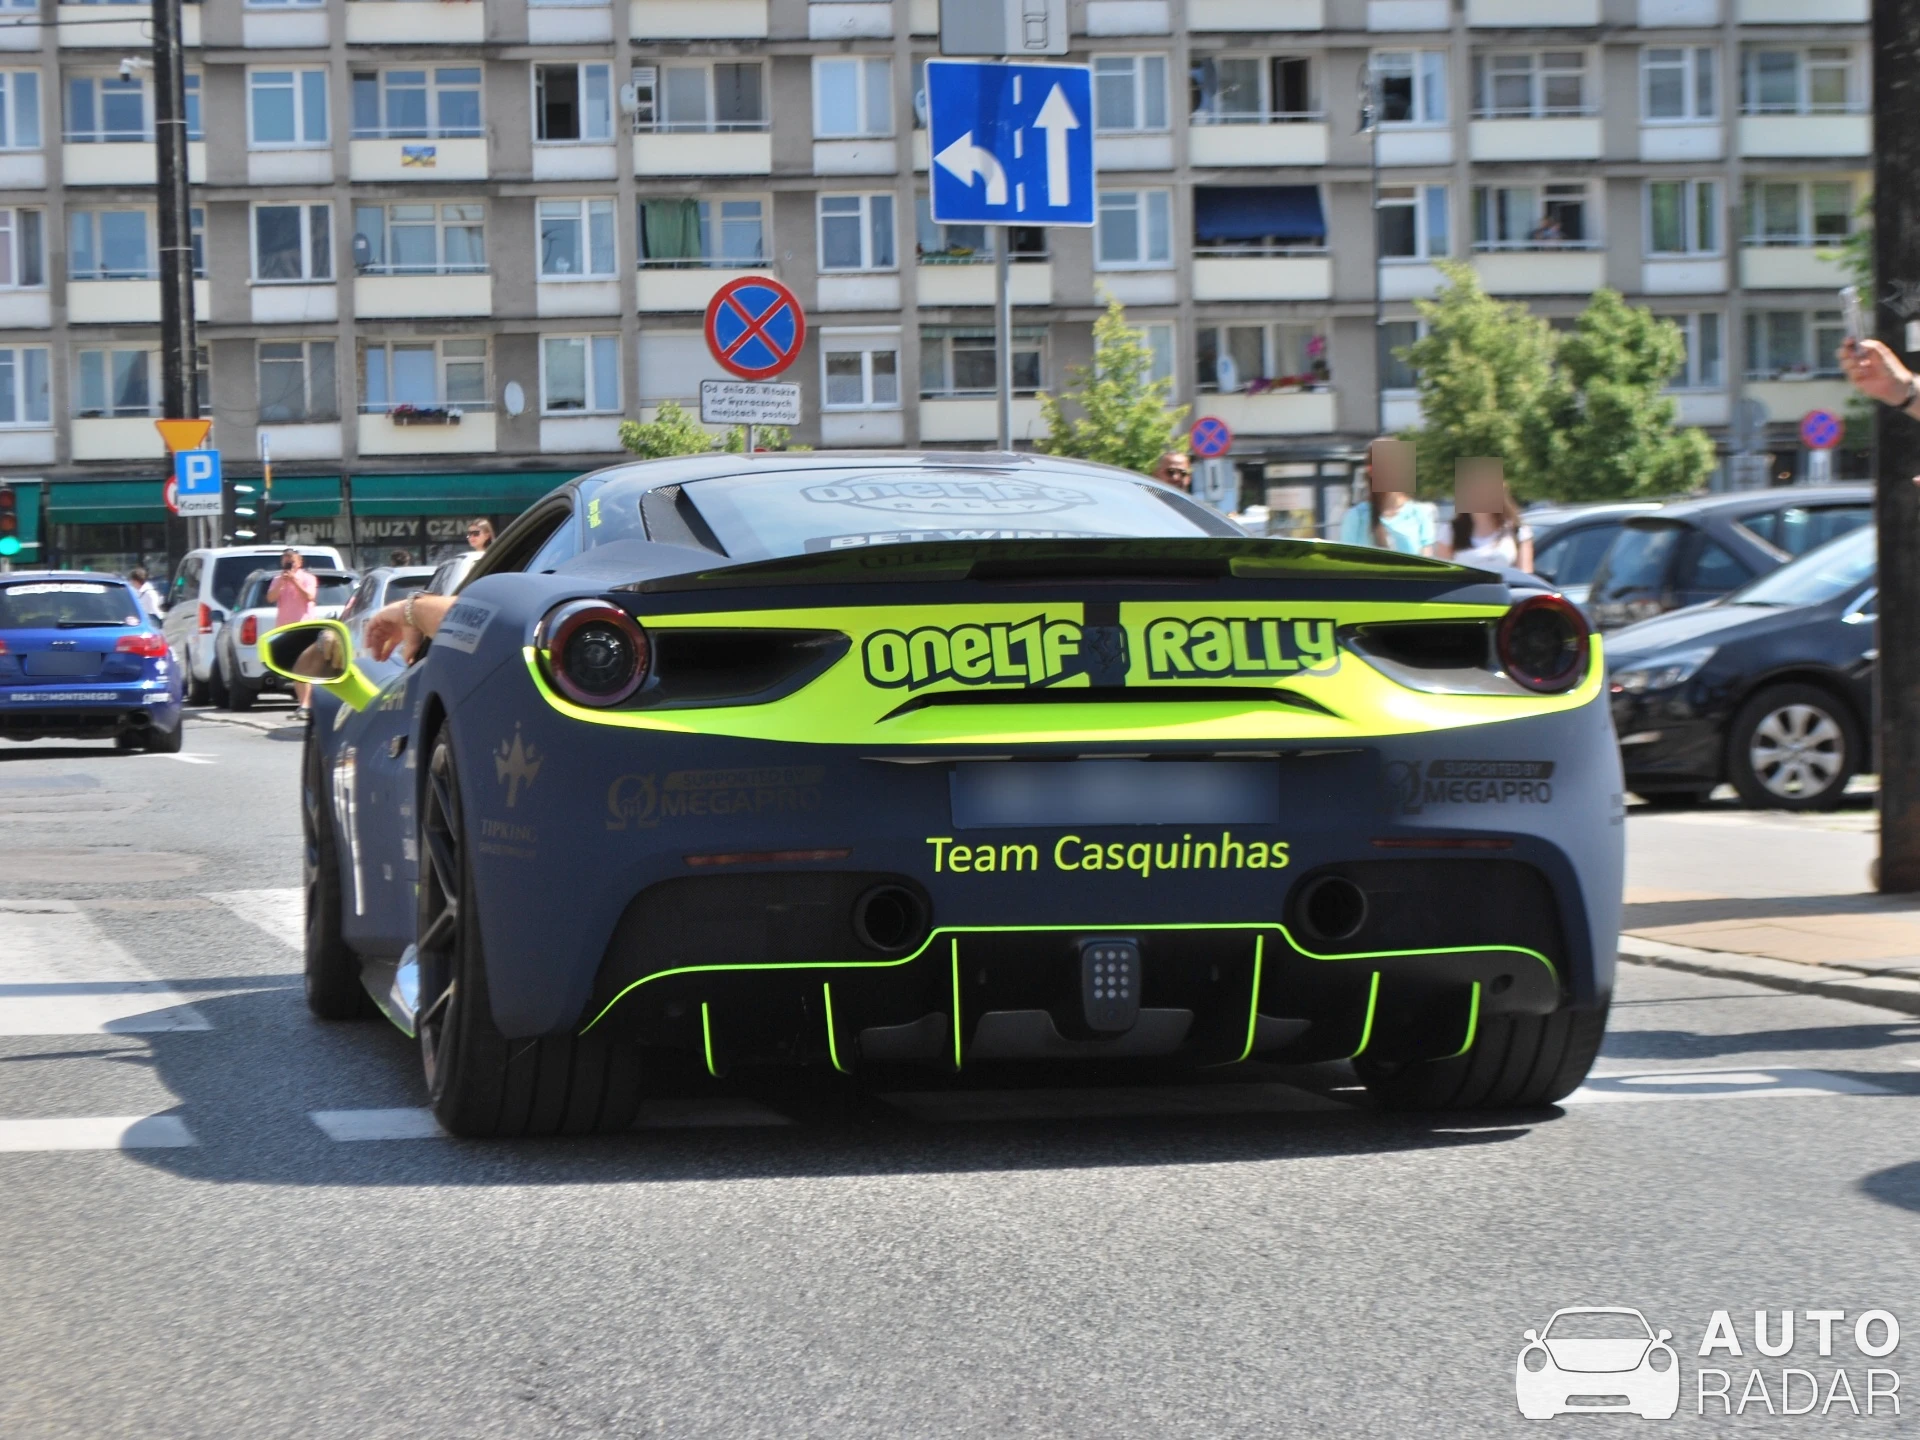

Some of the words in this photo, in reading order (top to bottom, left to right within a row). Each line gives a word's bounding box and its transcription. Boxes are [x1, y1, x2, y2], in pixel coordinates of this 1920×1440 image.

[185, 454, 213, 490] P
[180, 500, 220, 511] Koniec
[1443, 762, 1521, 777] SUPPORTED
[926, 837, 1039, 872] Team
[1054, 832, 1290, 877] Casquinhas
